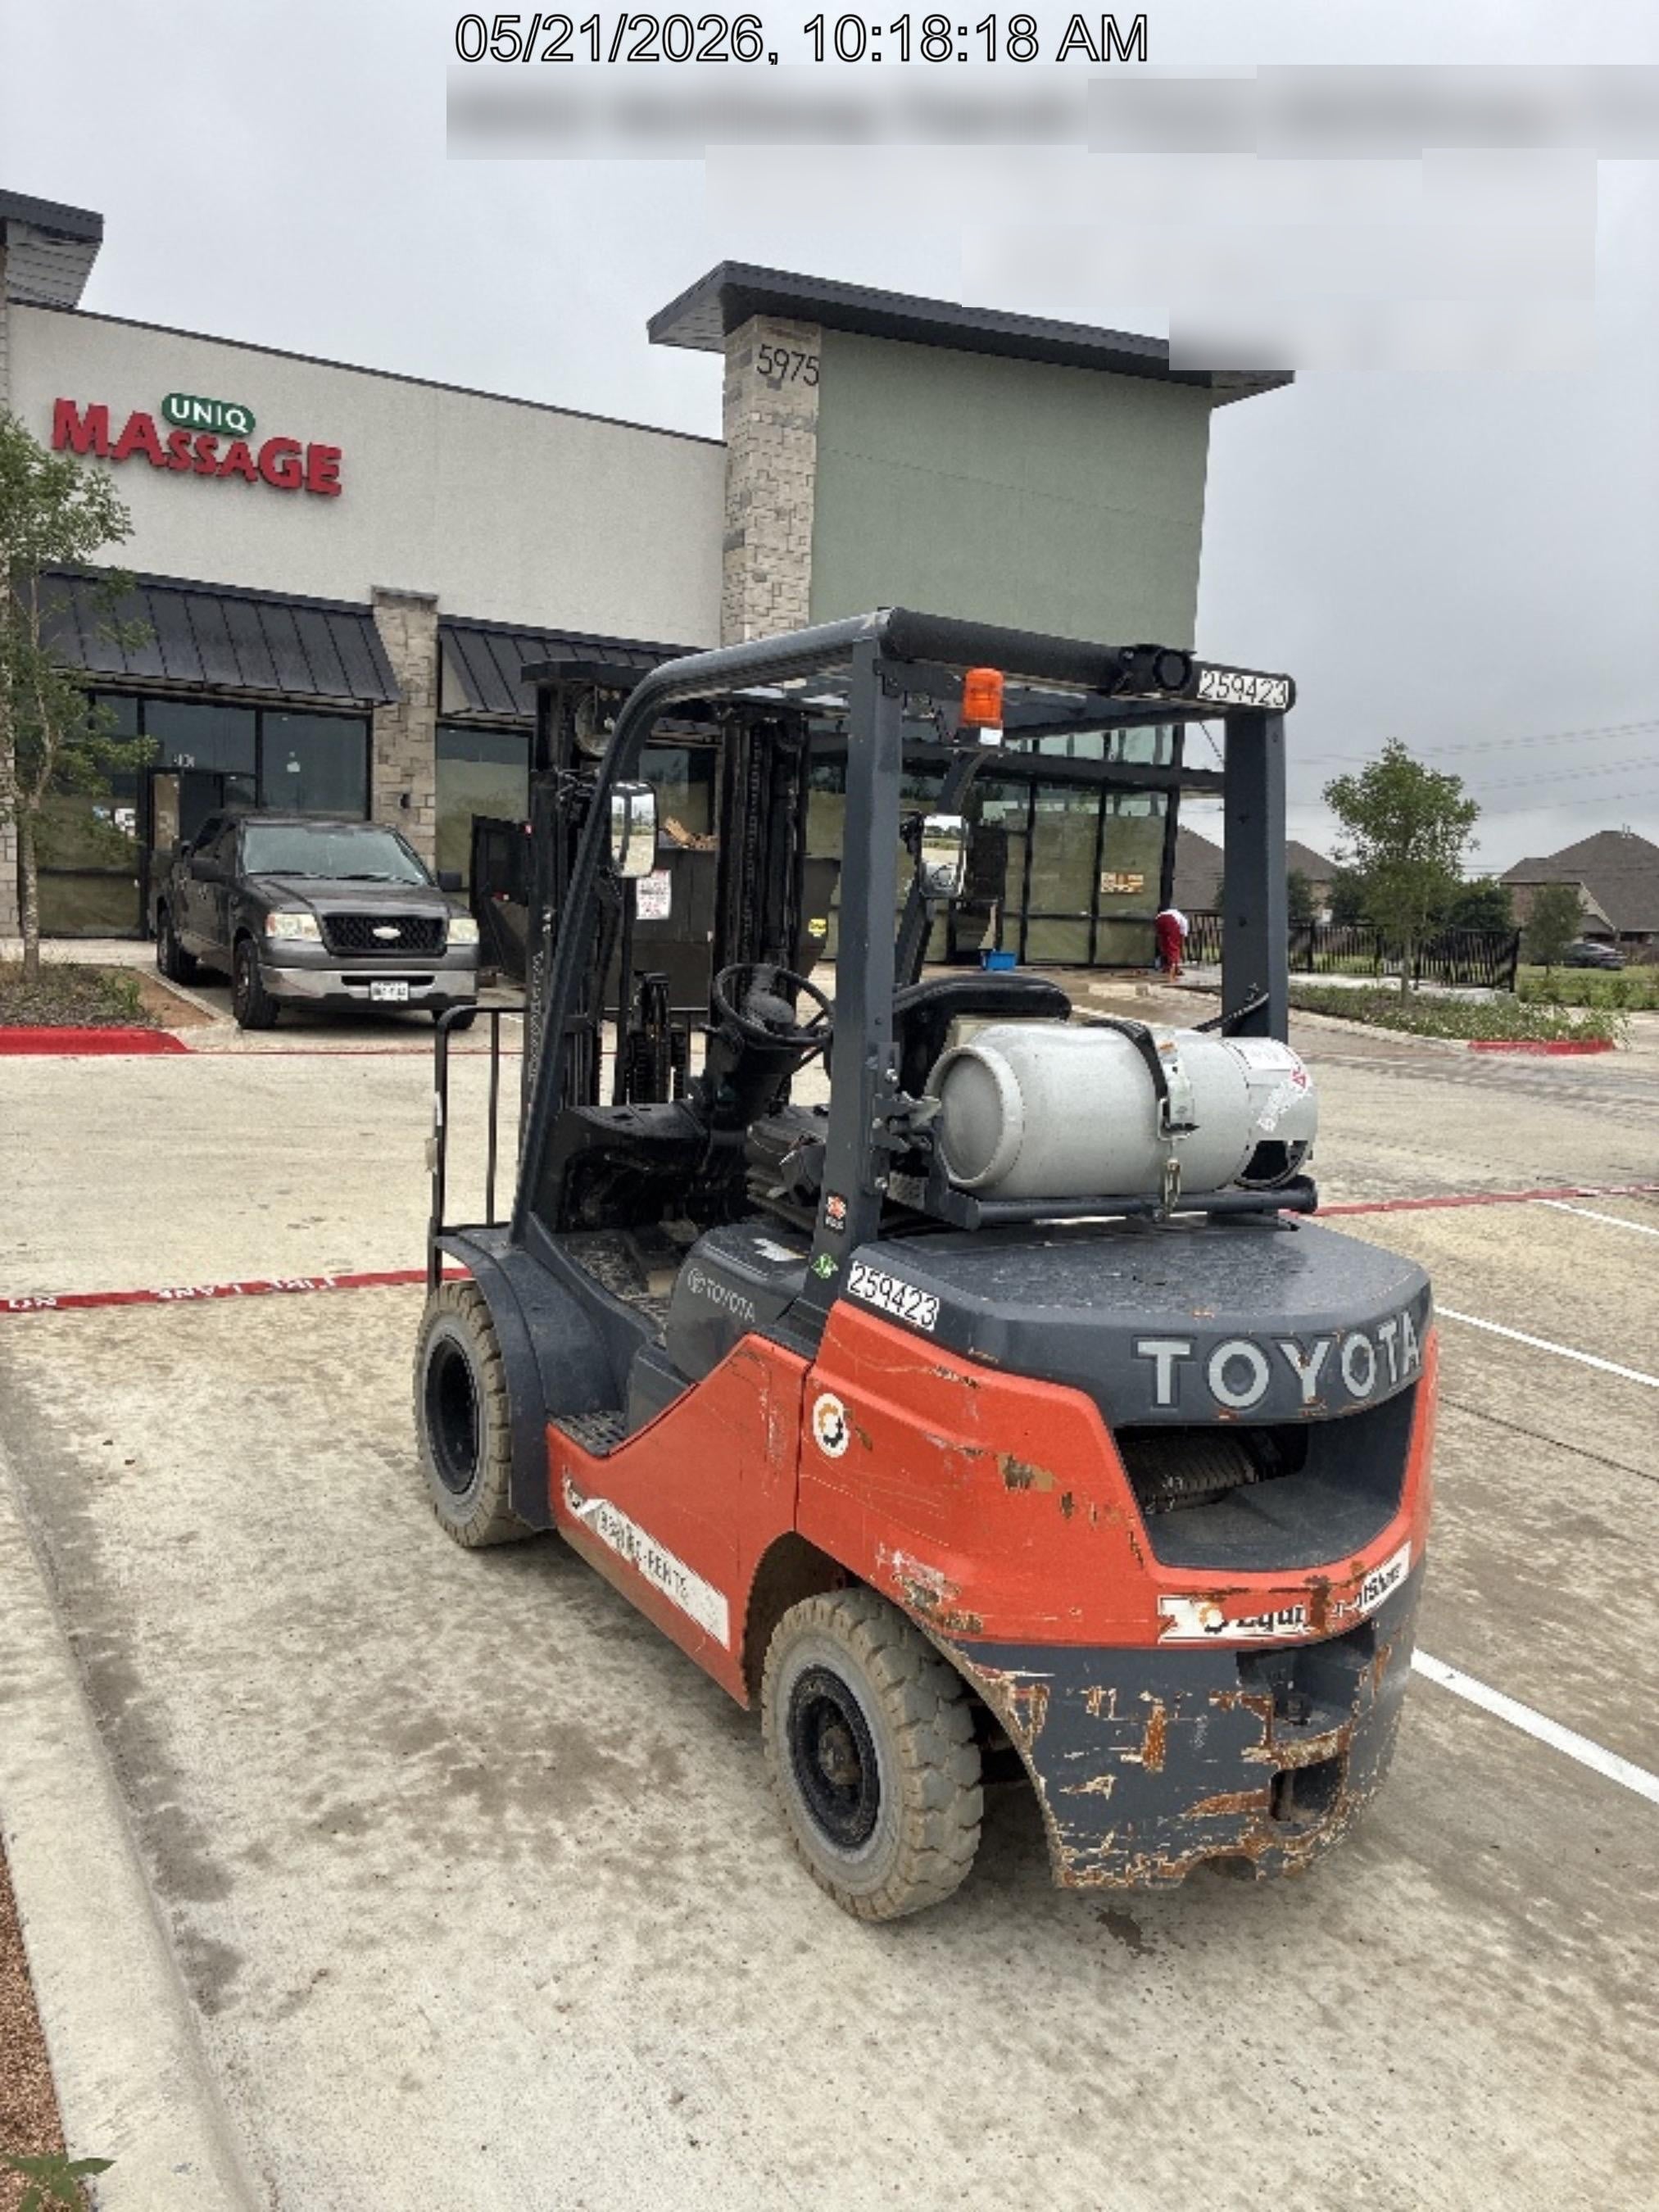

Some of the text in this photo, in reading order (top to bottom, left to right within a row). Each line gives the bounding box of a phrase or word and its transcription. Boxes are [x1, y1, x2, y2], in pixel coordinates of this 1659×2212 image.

[756, 342, 820, 388] 5975
[170, 397, 249, 433] UNIQ
[51, 397, 342, 497] MASSAGE
[1199, 670, 1288, 706] 259423
[708, 1279, 755, 1323] TOYOTA
[850, 1264, 938, 1327] 259423
[1136, 1311, 1421, 1409] TOYOTA
